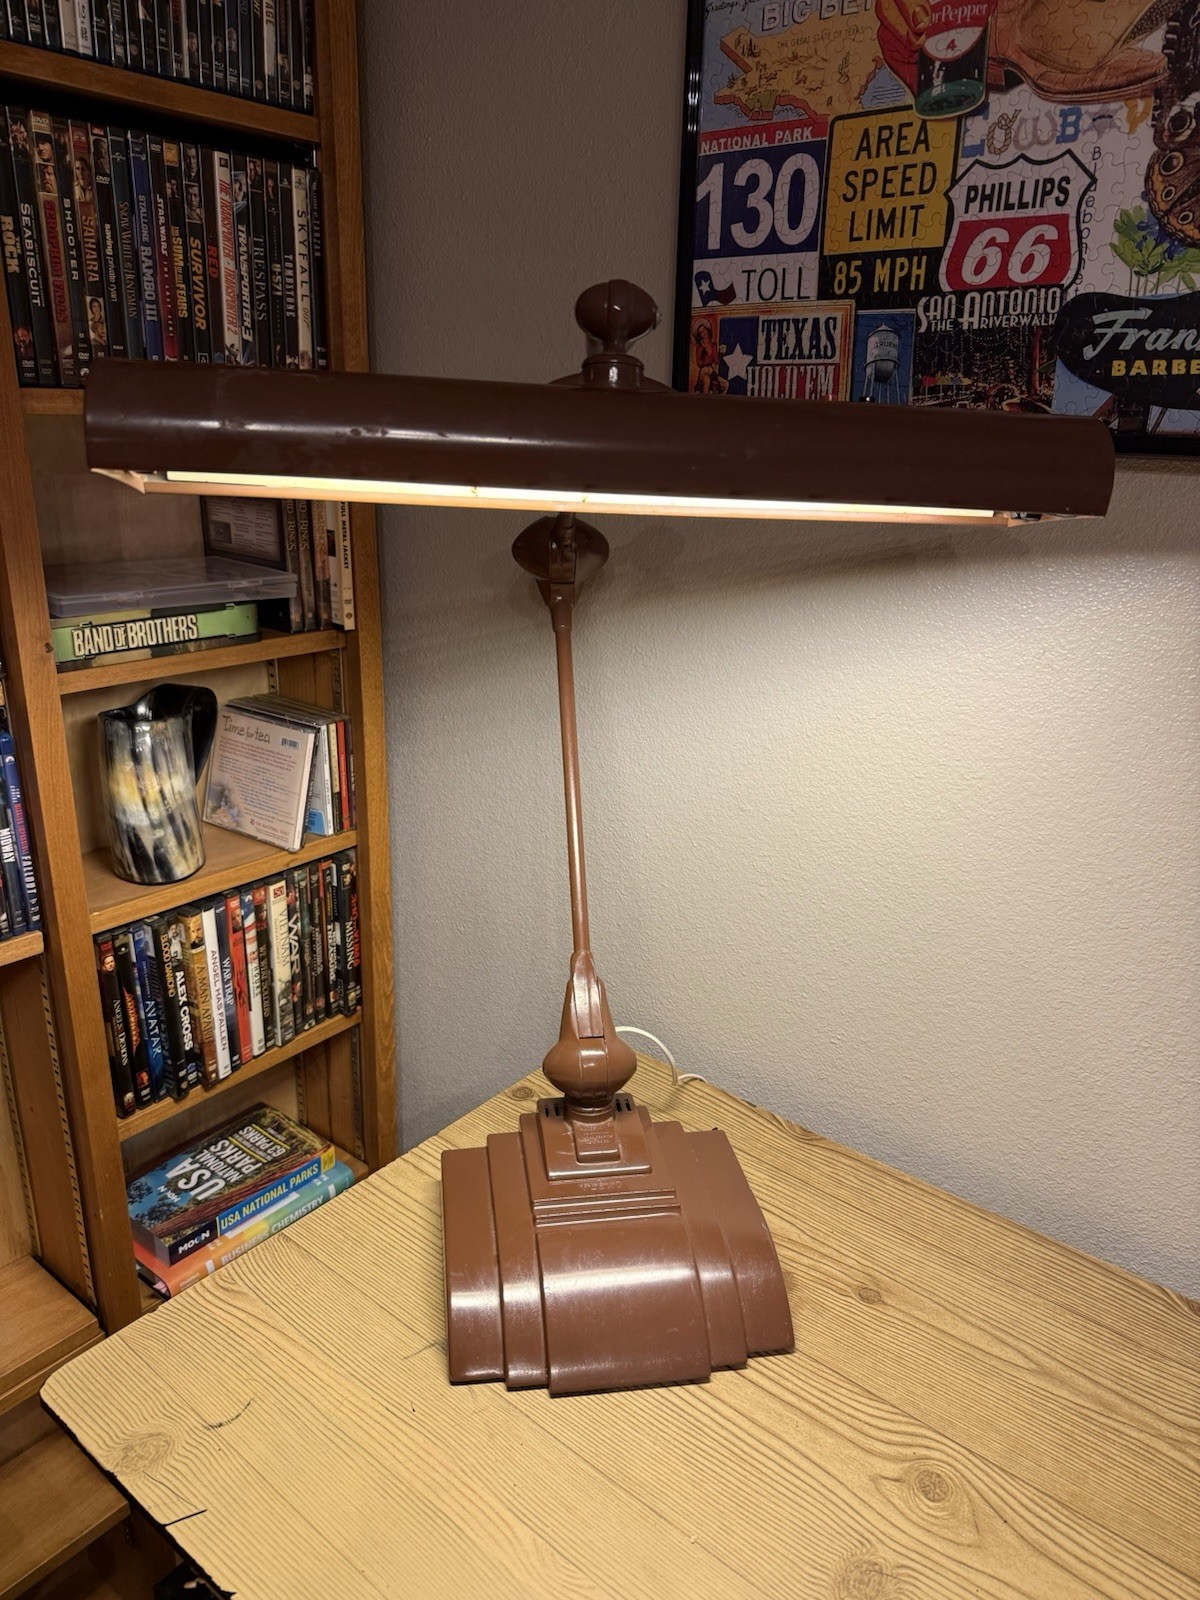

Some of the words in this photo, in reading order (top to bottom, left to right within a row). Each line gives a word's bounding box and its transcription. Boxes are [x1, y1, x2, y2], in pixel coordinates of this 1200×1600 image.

[761, 0, 811, 31] BIG
[946, 39, 957, 51] 4
[700, 132, 770, 154] NATIONAL
[775, 125, 814, 144] PARK
[855, 119, 930, 161] AREA
[696, 152, 820, 251] 130
[842, 162, 937, 203] SPEED
[963, 176, 1071, 214] PHILLIPS
[118, 201, 130, 229] SNOW
[138, 195, 150, 243] STALLONE
[220, 197, 234, 260] TRANSPORTER
[848, 204, 925, 242] LIMIT
[1, 215, 20, 274] ROCK
[21, 203, 41, 306] SEABISCUIT
[45, 200, 63, 278] SERAPHIM
[63, 197, 79, 281] SHOOTER
[82, 215, 100, 283] SAHARA
[104, 222, 114, 255] saving
[159, 225, 169, 257] WARS
[171, 236, 185, 267] SUM
[296, 210, 310, 303] SKYFALL
[961, 223, 1059, 286] 66
[140, 245, 156, 301] RAMBO
[208, 244, 219, 279] RED
[253, 235, 268, 321] TRESPASS
[833, 258, 863, 295] 85
[872, 255, 928, 293] MPH
[52, 279, 67, 323] FALLS
[175, 284, 188, 319] FEARS
[190, 236, 207, 330] SURVIVOR
[224, 265, 237, 326] TRANSPORTER
[284, 254, 296, 318] TOMBSTONE
[741, 266, 811, 301] TOLL
[145, 304, 158, 321] III
[917, 294, 957, 333] SAN
[957, 287, 1061, 330] ANTONIO
[930, 318, 954, 332] THE
[979, 313, 1058, 329] RIVERWALK
[761, 316, 837, 360] TEXAS
[340, 501, 349, 518] FULL
[341, 520, 350, 543] METAL
[342, 544, 350, 569] JACKET
[72, 626, 114, 657] BAND
[113, 624, 128, 650] OF
[128, 614, 198, 648] BROTHERS
[0, 827, 16, 862] MIDWAY
[22, 855, 38, 894] FALLOUT
[159, 933, 171, 963] BLOOD
[279, 908, 292, 967] VIETNAM
[288, 912, 301, 976] WAR
[345, 920, 355, 970] MISSING
[164, 962, 176, 998] DIAMOND
[211, 950, 221, 987] ANGEL
[222, 957, 232, 985] WAR
[253, 965, 262, 997] HOURS
[174, 971, 188, 1006] ALEX
[197, 974, 209, 1006] MAN
[215, 988, 225, 1011] HAS
[225, 985, 235, 1006] TRAP
[261, 981, 270, 1018] SOLDIERS
[145, 1000, 163, 1059] AVATAR
[180, 1006, 194, 1051] CROSS
[200, 1006, 214, 1041] APART
[217, 1012, 228, 1051] FALLEN
[209, 1139, 263, 1176] PARKS
[238, 1126, 271, 1151] PARKS
[266, 1145, 287, 1158] 63
[165, 1157, 226, 1201] USA
[195, 1149, 244, 1184] NATIONAL
[220, 1212, 242, 1230] USA
[241, 1185, 289, 1217] NATIONAL
[289, 1163, 320, 1190] PARKS
[271, 1194, 325, 1233] CHEMISTRY
